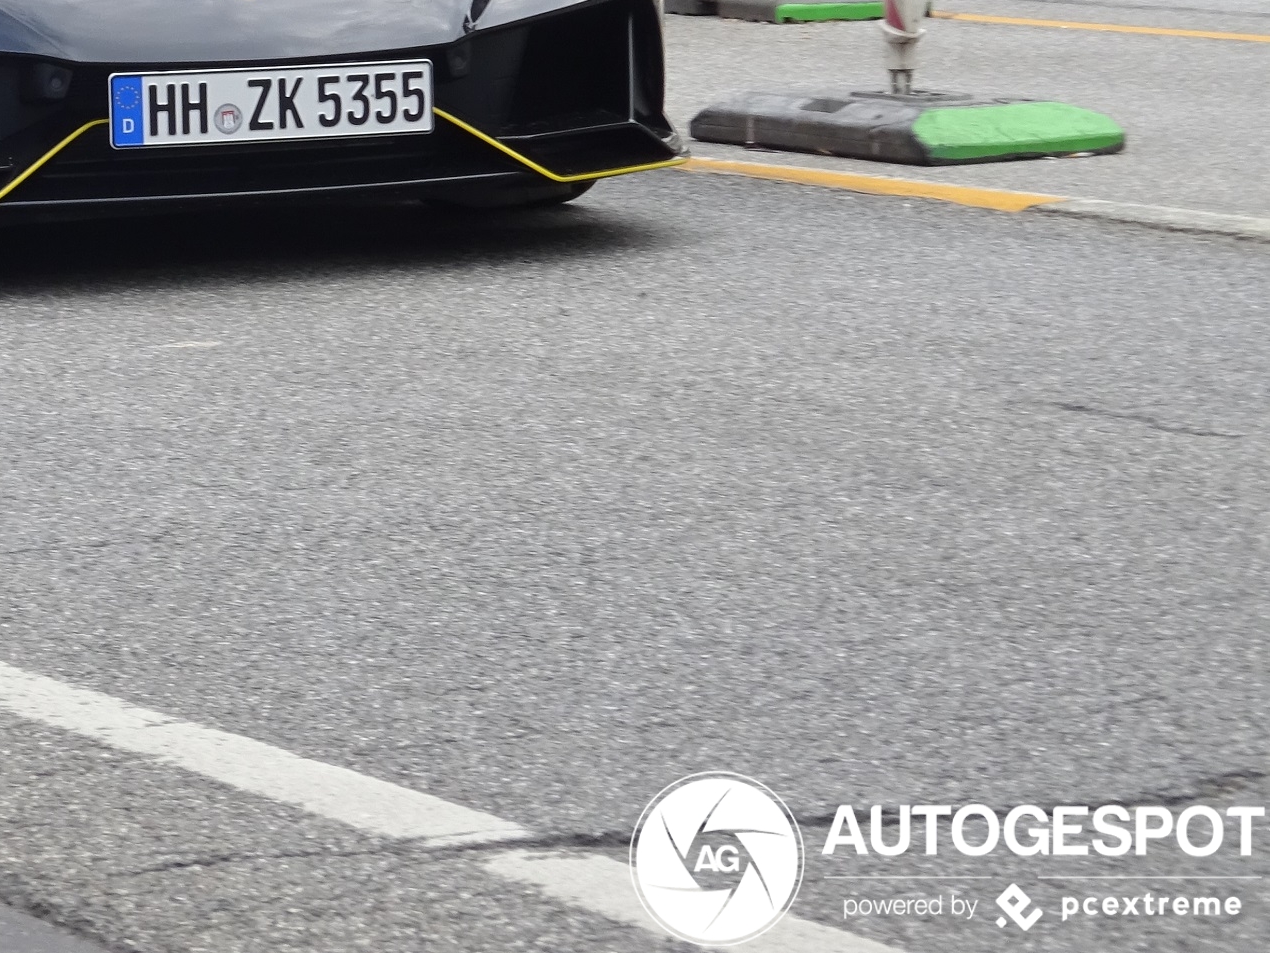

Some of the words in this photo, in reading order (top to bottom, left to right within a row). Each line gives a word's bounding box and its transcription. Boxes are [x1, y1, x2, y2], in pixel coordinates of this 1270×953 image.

[122, 118, 135, 134] D
[148, 82, 208, 136] HH
[247, 77, 304, 131] ZK
[317, 70, 425, 128] 5355
